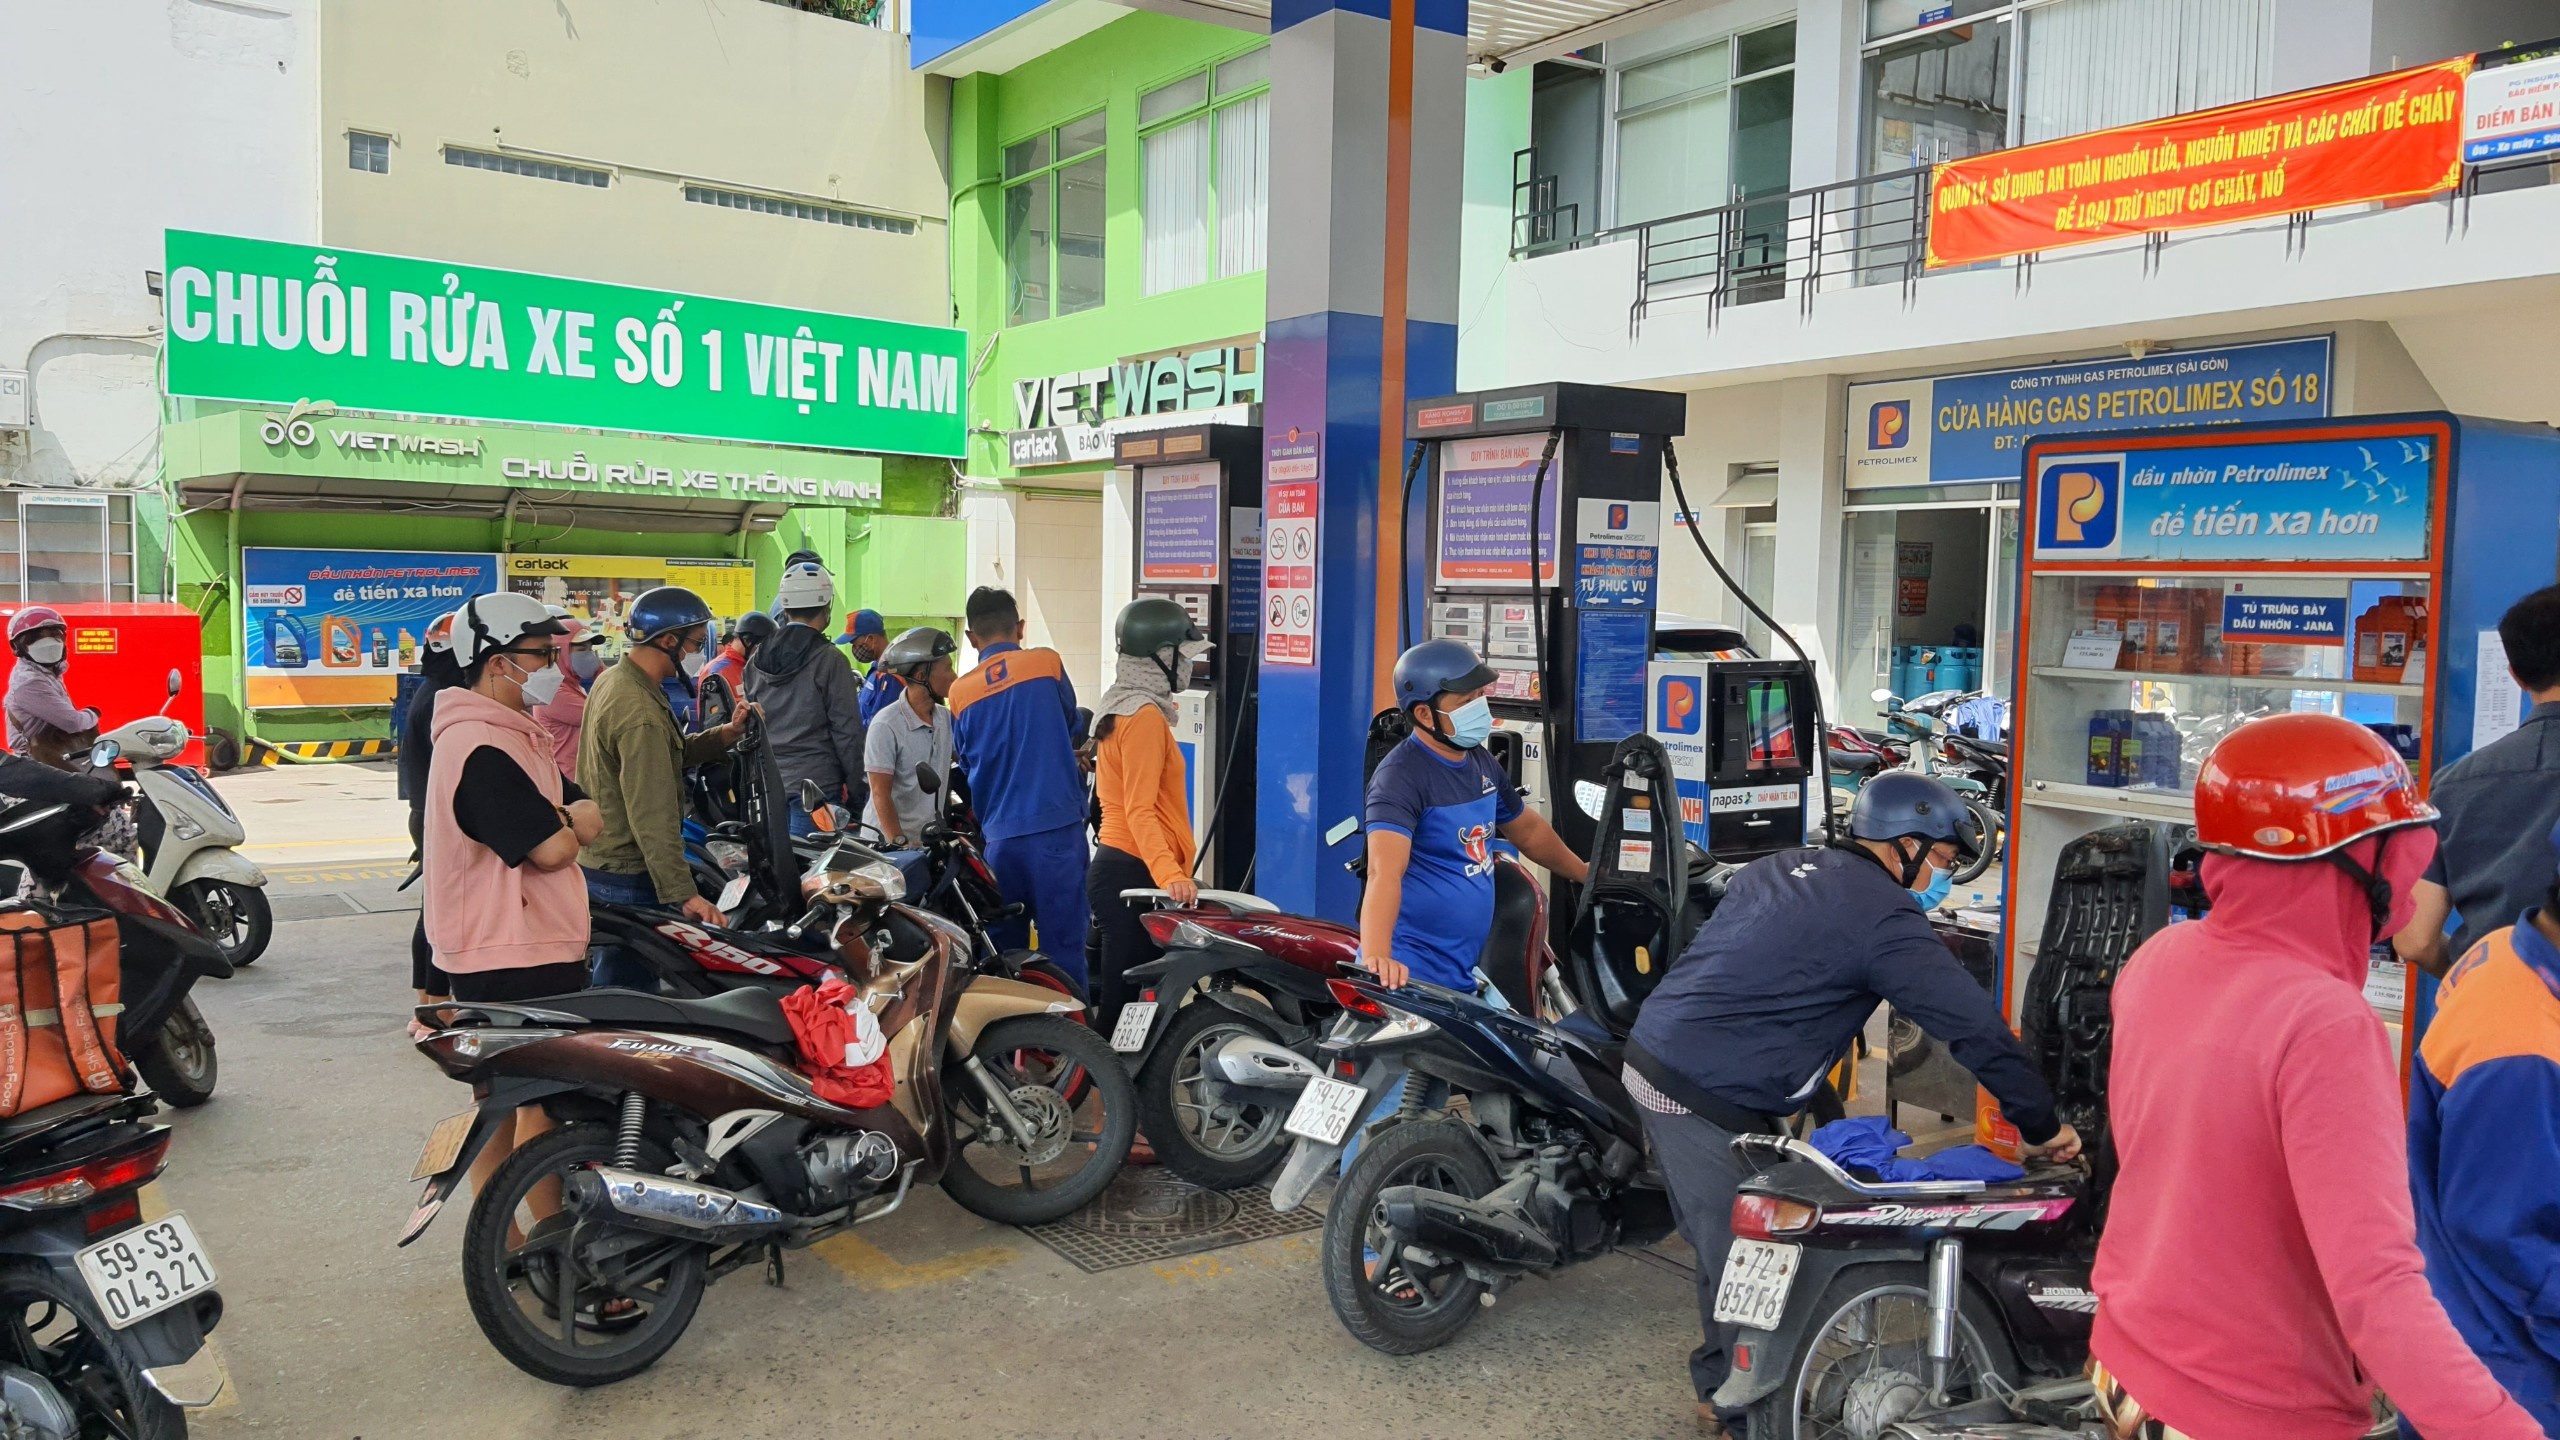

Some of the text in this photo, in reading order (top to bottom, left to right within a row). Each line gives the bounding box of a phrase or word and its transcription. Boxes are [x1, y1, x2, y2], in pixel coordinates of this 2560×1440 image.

[2477, 101, 2554, 130] ĐIỂM BÁN
[1939, 177, 1969, 213] QUẢN
[1991, 168, 2010, 202] SỬ
[2011, 170, 2044, 203] DỤNG
[2047, 165, 2065, 193] AN
[2068, 154, 2100, 188] TOÀN
[2104, 141, 2150, 182] NGUỒN
[2152, 137, 2181, 174] LỬA,
[2185, 125, 2235, 168] NGUỒN
[2237, 120, 2281, 160] NHIỆT
[2283, 115, 2303, 150] VÀ
[2306, 110, 2337, 146] CÁC
[2339, 96, 2381, 138] CHẤT
[2383, 89, 2408, 131] DỄ
[2409, 85, 2457, 125] CHÁY
[2497, 142, 2510, 152] Xe
[2512, 137, 2534, 150] máy
[2055, 157, 2287, 232] ĐỂ LOẠI TRỪ NGUY CƠ CHÁY, NỔ
[170, 255, 958, 415] CHUỖI RỬA XE SỐ 1 VIỆT NAM
[2010, 357, 2229, 390] CÔNG TY TNHH GAS PETROLIMEX (SÀI GÒN)
[1013, 342, 1264, 430] VIETWASH
[1938, 368, 2318, 432] CỬA HÀNG GAS PETROLIMEX SỐ 18
[329, 430, 480, 457] VIETWASH
[1014, 431, 1058, 460] carlack
[1079, 428, 1100, 450] BẢO
[1994, 435, 2018, 450] ĐT:
[1470, 446, 1529, 461] QUY TRÌNH BÁN HÀNG
[1858, 456, 1918, 467] PETROLIMEX
[502, 451, 882, 500] CHUỖI RỬA XE THÔNG MINH
[2131, 463, 2330, 487] dầu nhờn Petrolimex
[1278, 500, 1305, 514] CỦA BẠN
[2150, 500, 2379, 537] để tiến xa hơn
[1590, 533, 1623, 541] Petrolimex
[1584, 546, 1652, 561] KHU VỰC DÀNH CHO
[383, 566, 481, 579] PETROLIMEX
[515, 558, 569, 570] carlack
[1581, 562, 1604, 576] KHÁCH
[1606, 562, 1625, 576] HÀNG
[333, 583, 463, 601] để tiến xa hơn
[1581, 577, 1647, 597] TỰ PHỤC VỤ
[2242, 601, 2258, 614] TỦ
[2261, 602, 2299, 615] TRƯNG
[2302, 621, 2334, 631] JANA
[1194, 722, 1203, 734] 09
[1525, 744, 1539, 759] 06
[1712, 794, 1743, 808] napas
[1123, 1006, 1150, 1026] 59-H1
[1115, 1028, 1146, 1048] 789.47
[2, 1024, 18, 1108] ShopeeFood
[1313, 1080, 1356, 1113] 59-L2
[1869, 1204, 1958, 1223] Dream
[95, 1222, 184, 1280] 59-S3
[1744, 1246, 1774, 1280] 72
[105, 1252, 211, 1321] 043.21
[2042, 1287, 2086, 1296] HONDA
[1719, 1281, 1782, 1319] 852F6
